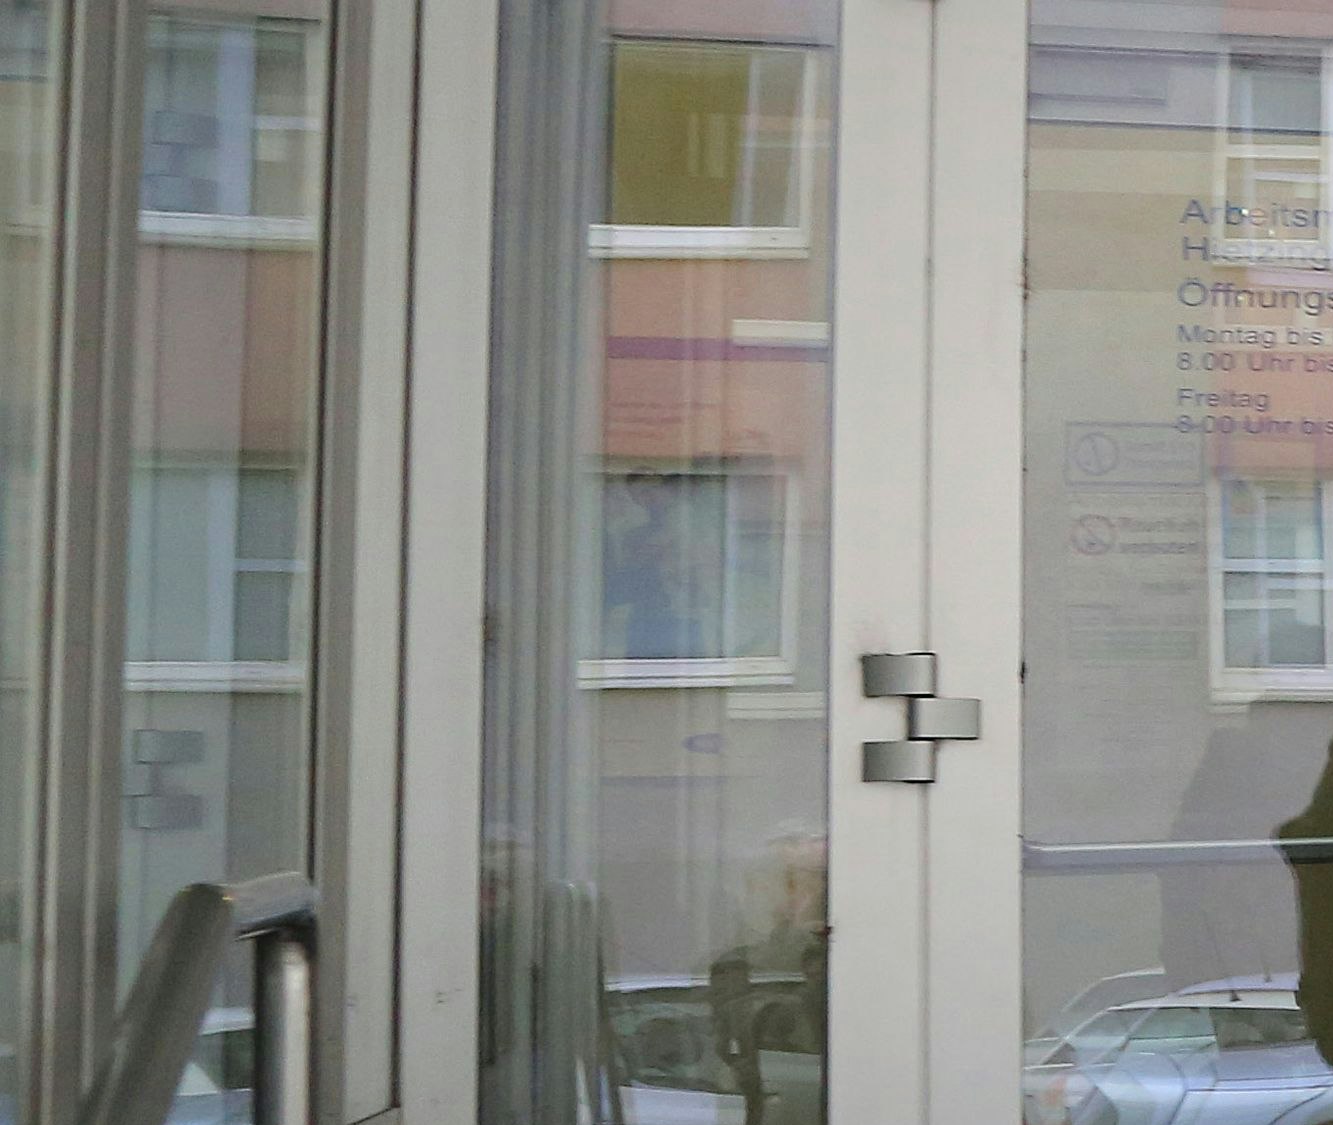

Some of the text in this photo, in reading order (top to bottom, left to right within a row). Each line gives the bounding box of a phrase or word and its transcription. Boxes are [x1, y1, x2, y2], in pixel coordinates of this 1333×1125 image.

[1176, 324, 1277, 350] Montag
[1287, 326, 1324, 346] bis
[1176, 351, 1234, 372] 8.00
[1249, 352, 1295, 373] Uhr
[1176, 387, 1270, 412] Freitag
[1243, 415, 1296, 435] Uhr
